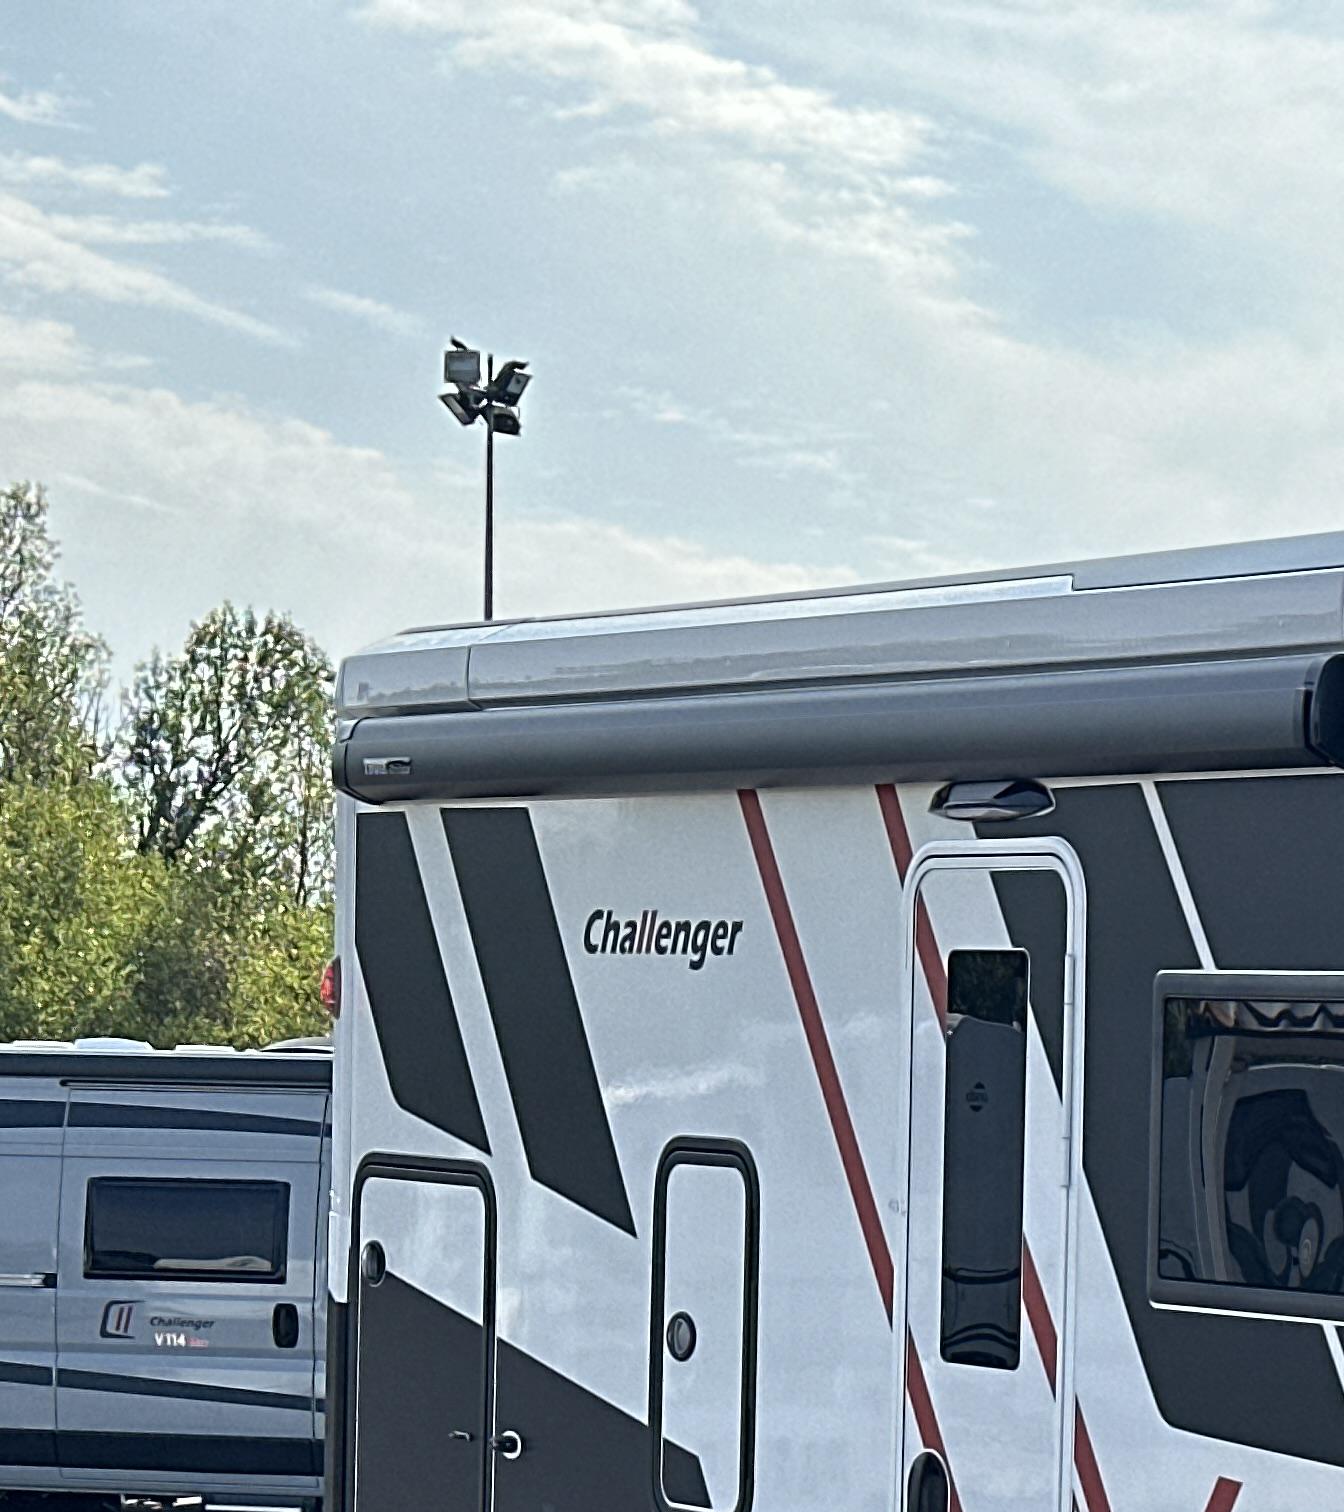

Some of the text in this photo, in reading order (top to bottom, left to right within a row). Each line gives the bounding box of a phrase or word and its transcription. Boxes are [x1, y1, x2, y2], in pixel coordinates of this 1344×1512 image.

[583, 909, 744, 970] Challenger
[149, 1316, 215, 1331] Challenger
[154, 1332, 187, 1347] V114
